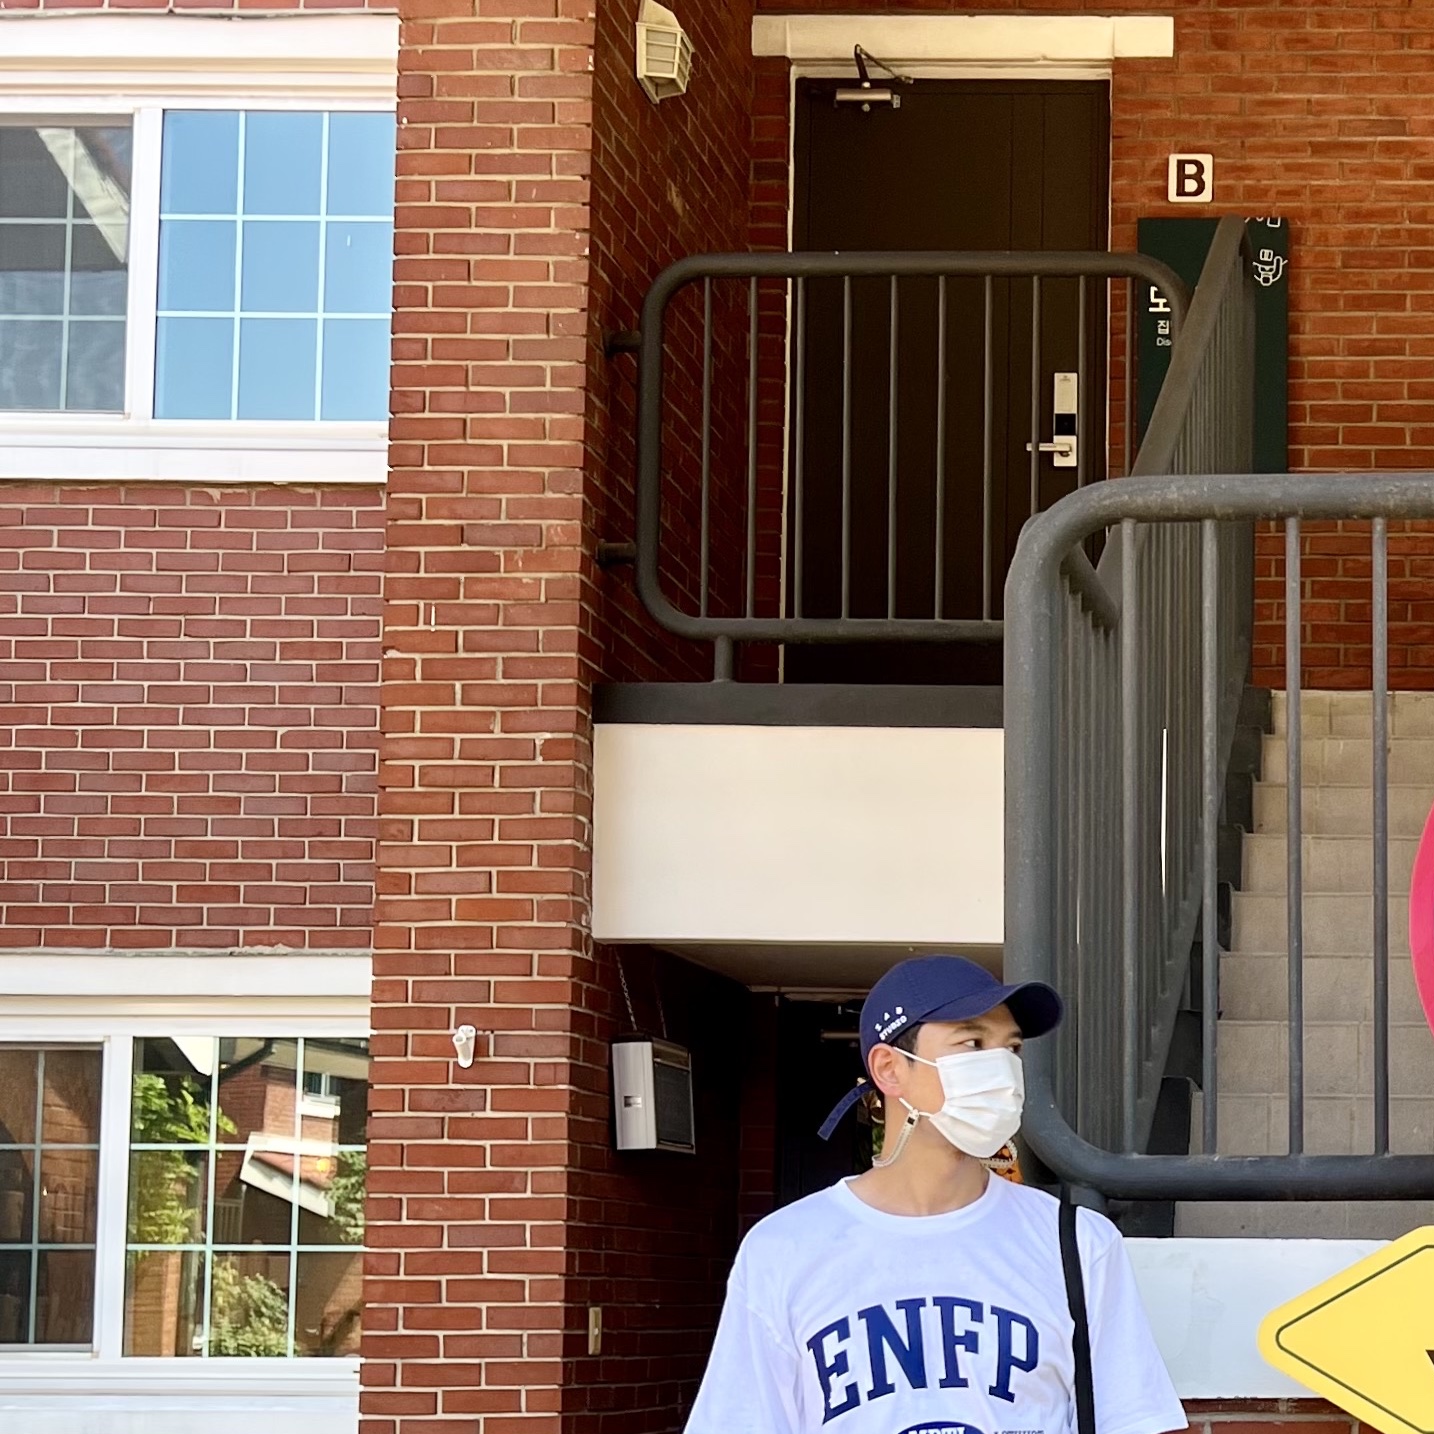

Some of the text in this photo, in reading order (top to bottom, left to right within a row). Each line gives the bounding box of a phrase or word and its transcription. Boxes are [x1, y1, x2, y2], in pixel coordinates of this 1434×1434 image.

[1176, 159, 1206, 198] B
[878, 1015, 908, 1041] STUDIO
[806, 1296, 1040, 1426] ENFP
